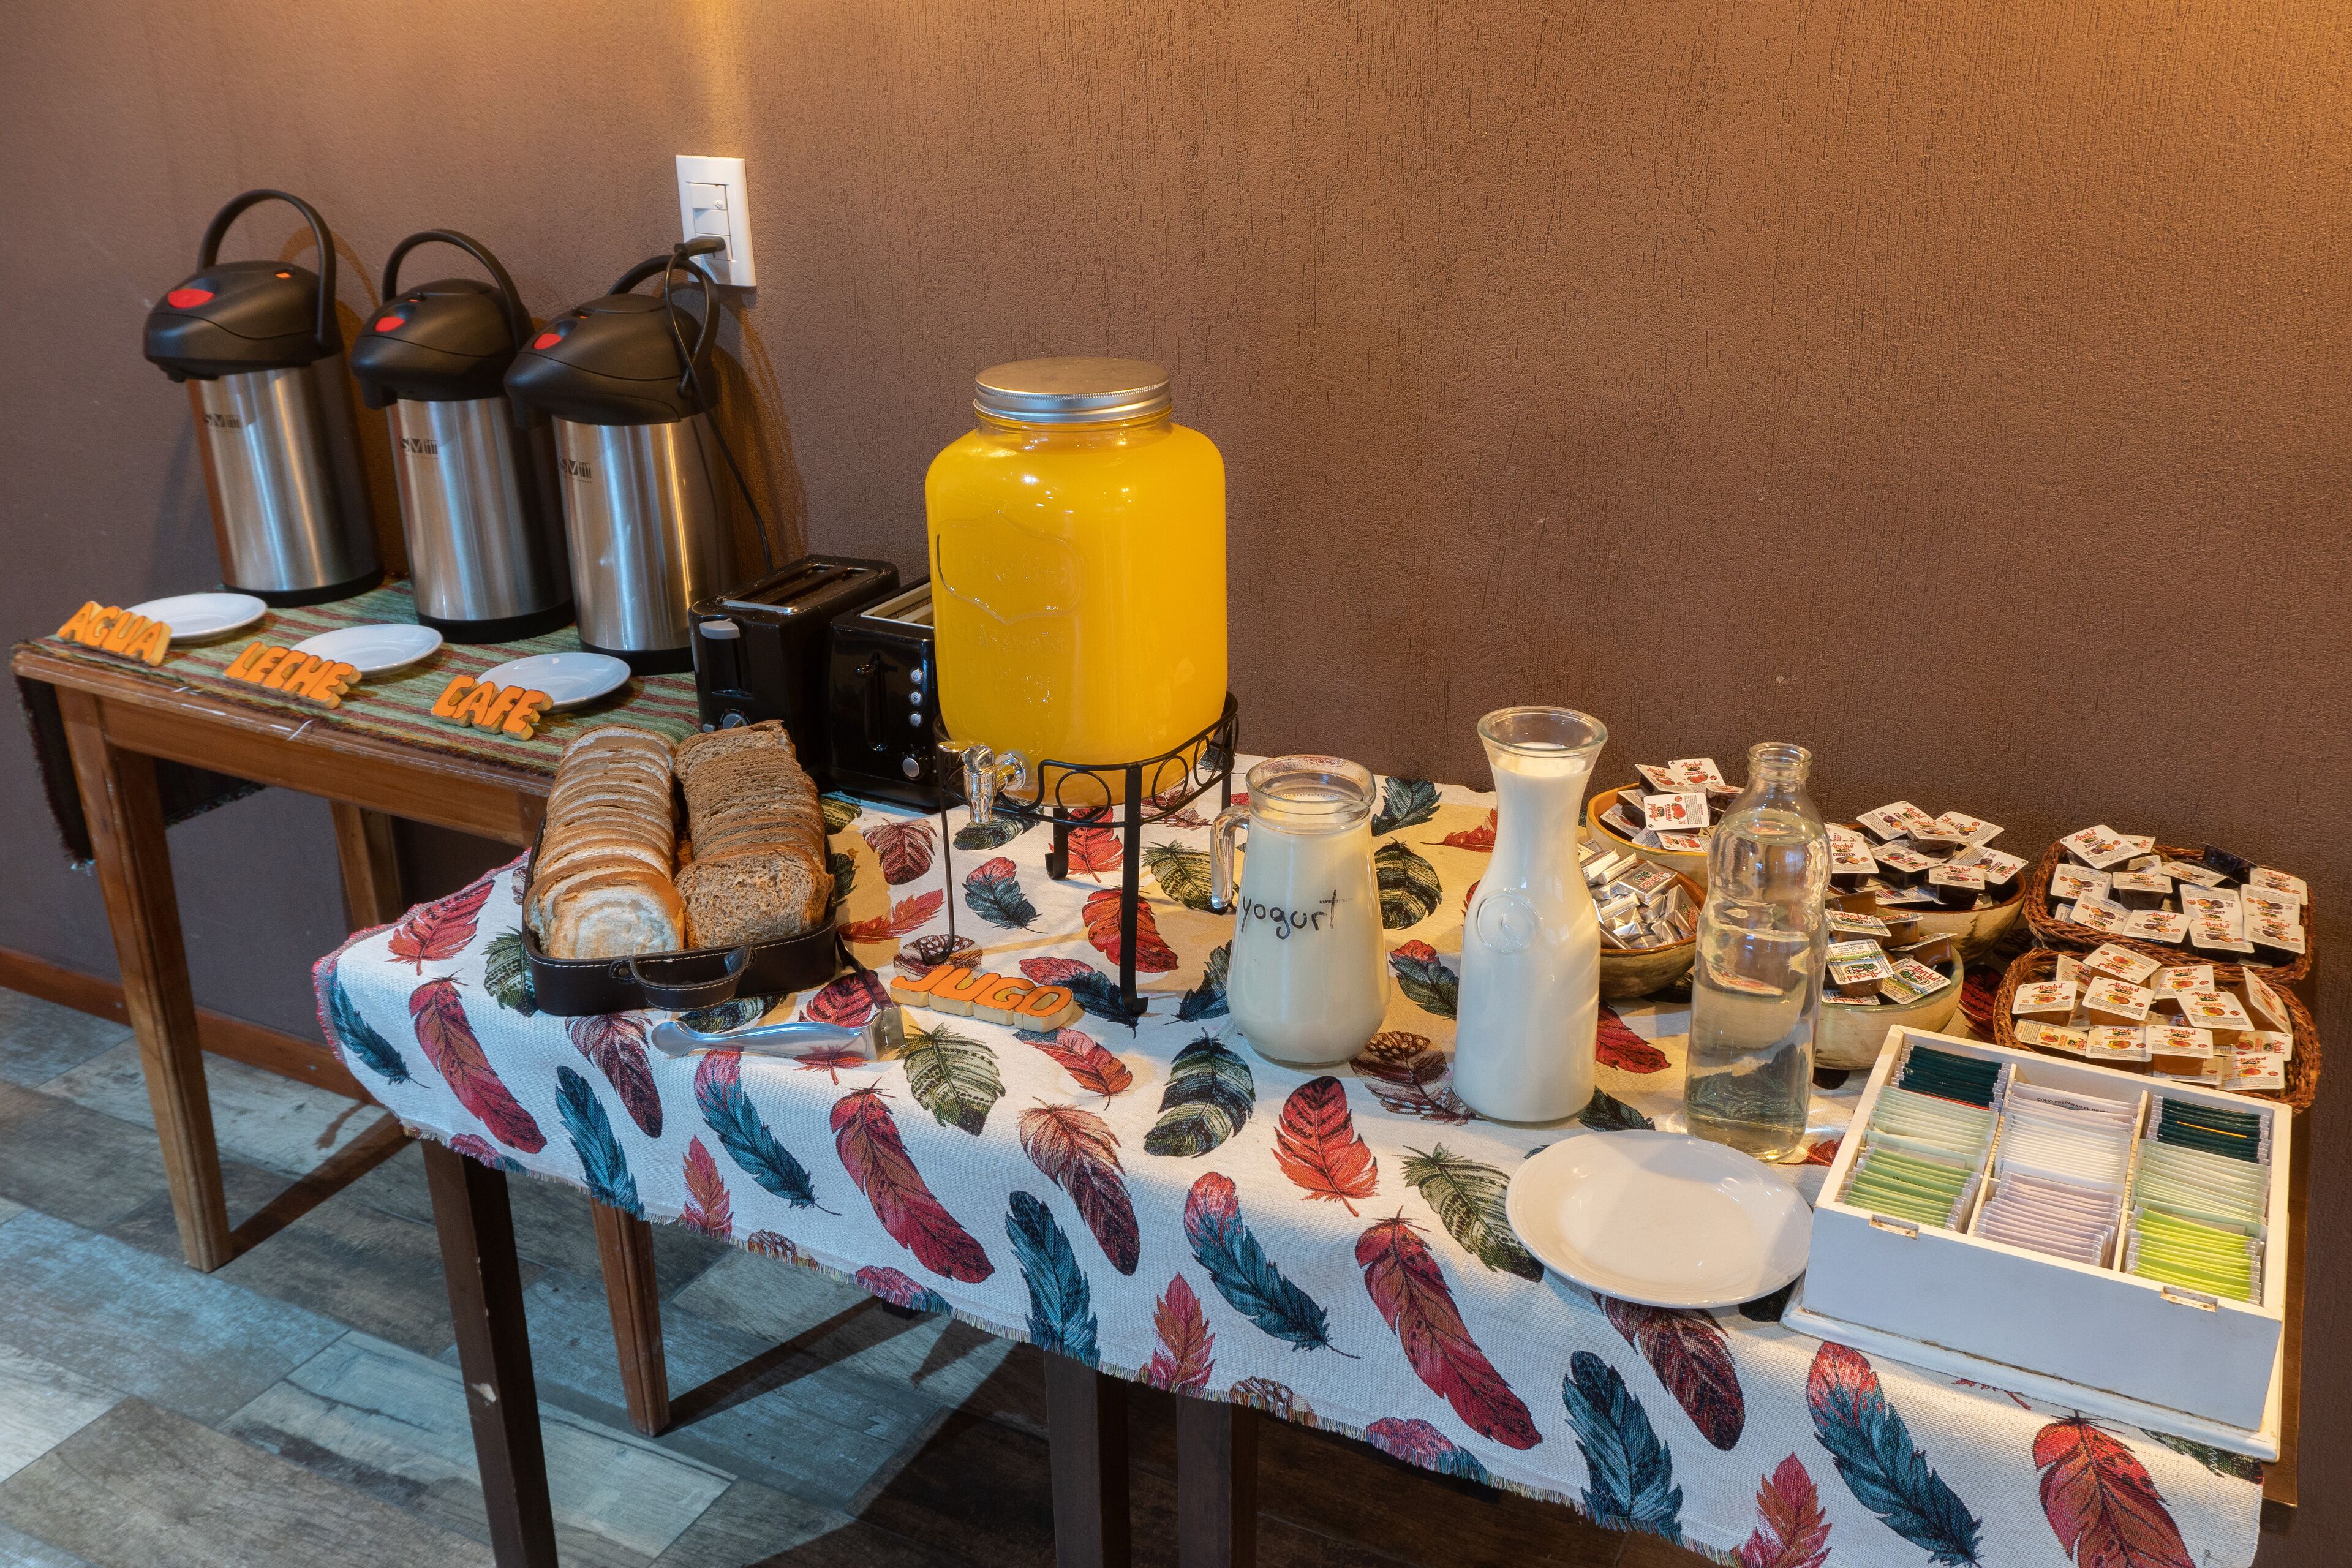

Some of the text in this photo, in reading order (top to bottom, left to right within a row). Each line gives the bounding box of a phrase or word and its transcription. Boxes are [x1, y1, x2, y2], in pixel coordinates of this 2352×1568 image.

[58, 600, 173, 667] AGUA
[224, 641, 361, 710] LECHE
[431, 675, 554, 741] CAFE
[2074, 829, 2098, 843] Abedul
[1639, 872, 1664, 889] Abedul
[1241, 889, 1353, 940] yogurt
[1834, 911, 1868, 920] Abedul
[2146, 911, 2178, 920] Abedul
[1847, 970, 1883, 982] Abedul
[1906, 965, 1942, 982] Abedul
[2071, 964, 2091, 975] Abe
[2095, 962, 2130, 975] Abedul
[2108, 982, 2143, 993] Abedul
[890, 965, 1074, 1033] JUGO
